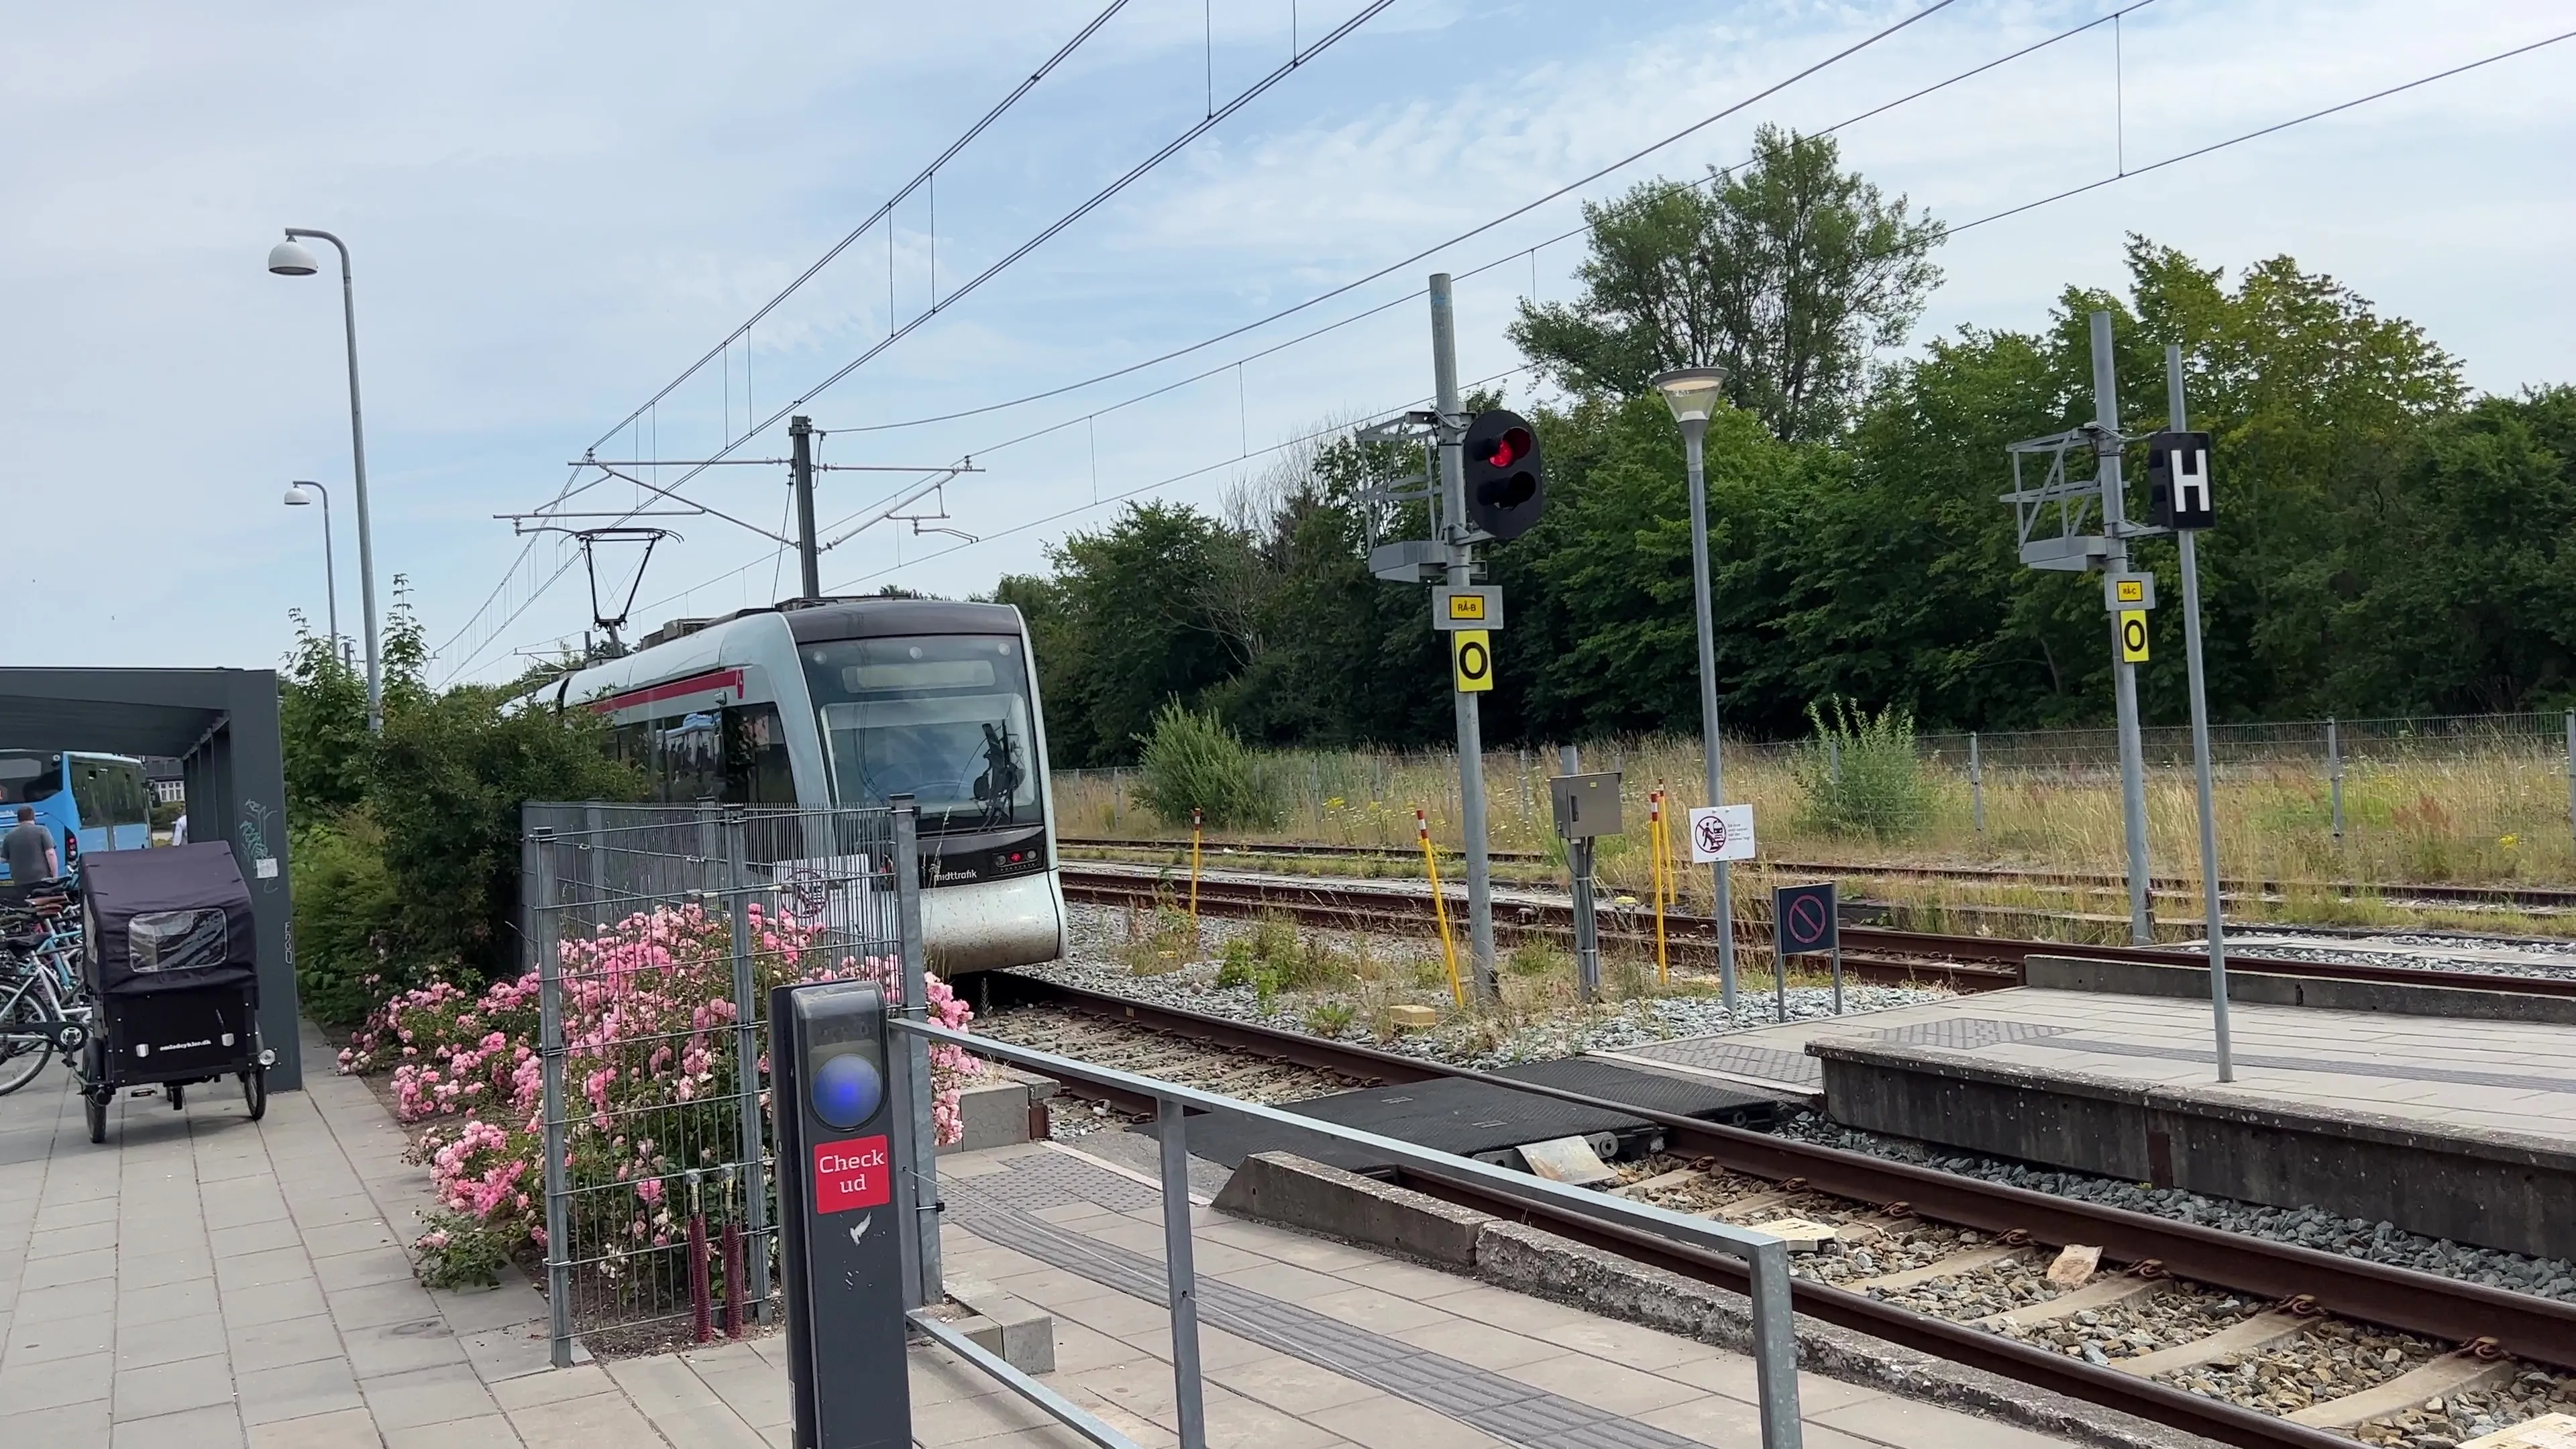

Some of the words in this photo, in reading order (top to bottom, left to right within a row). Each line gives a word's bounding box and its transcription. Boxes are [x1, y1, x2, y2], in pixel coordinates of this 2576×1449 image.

[2171, 449, 2210, 513] H
[1458, 601, 1477, 612] RÅ-B
[933, 869, 977, 881] midttrafik
[819, 1148, 885, 1174] Check
[839, 1173, 867, 1194] ud
